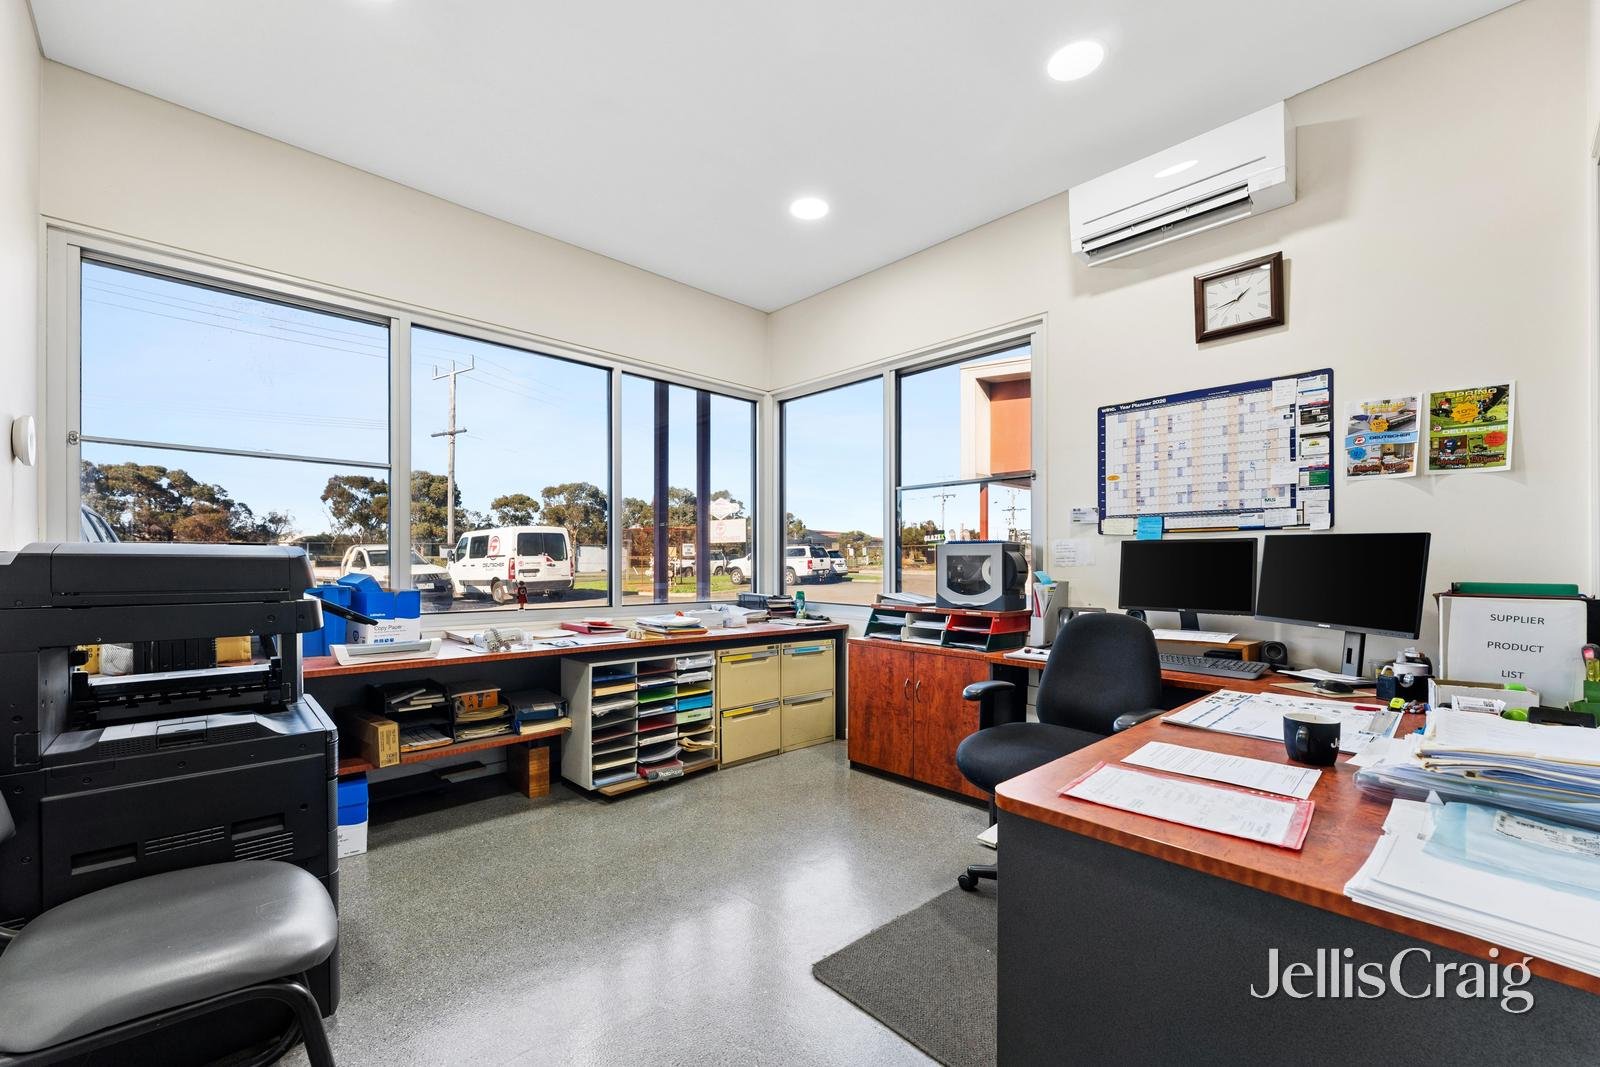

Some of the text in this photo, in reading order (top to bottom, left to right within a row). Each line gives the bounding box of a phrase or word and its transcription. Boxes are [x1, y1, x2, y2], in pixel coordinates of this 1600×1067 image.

[1442, 425, 1505, 435] DEUTSCHER
[1368, 432, 1411, 441] DEUTSCHER
[1489, 613, 1545, 625] SUPPLIER
[1486, 640, 1544, 653] PRODUCT
[1501, 669, 1525, 680] LIST
